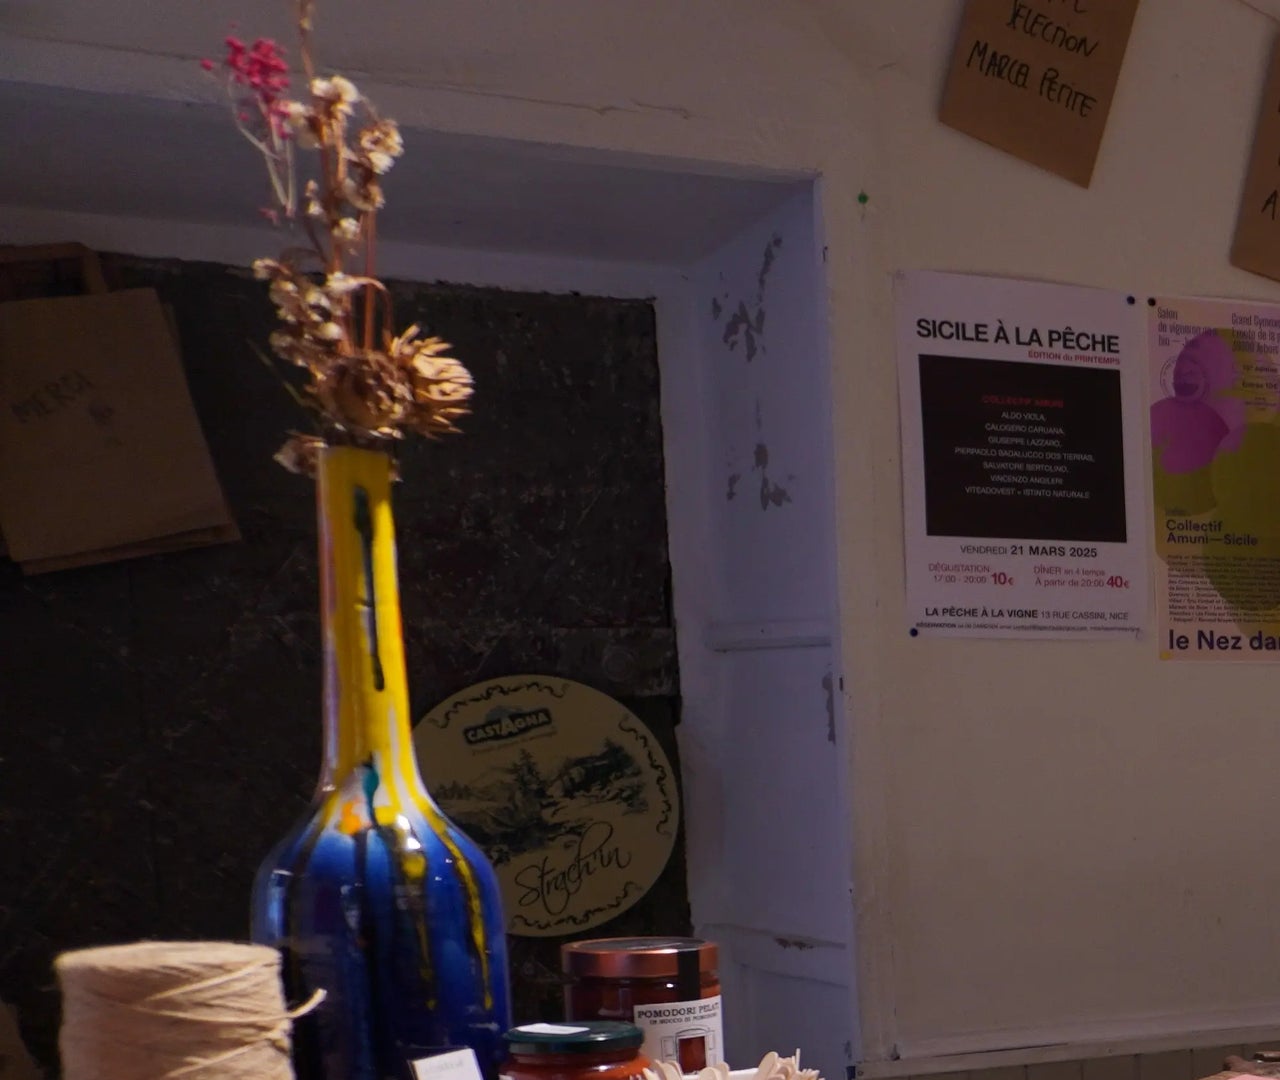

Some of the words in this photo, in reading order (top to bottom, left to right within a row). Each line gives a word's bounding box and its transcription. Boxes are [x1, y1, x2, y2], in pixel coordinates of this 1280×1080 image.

[916, 318, 989, 343] SICILE
[994, 319, 1009, 344] À
[1015, 327, 1043, 347] LA
[1048, 326, 1120, 353] PÊCHE
[1075, 355, 1120, 365] PRINTEMPS
[1166, 519, 1223, 532] Collectif
[960, 545, 1008, 555] VENDREDI
[1010, 545, 1024, 556] 21
[1029, 545, 1065, 557] MARS
[1069, 546, 1097, 558] 2025
[1044, 578, 1066, 589] partir
[1068, 578, 1079, 587] de
[925, 607, 940, 617] LA
[942, 606, 979, 618] PÊCHE
[980, 606, 990, 618] À
[991, 608, 1006, 618] LA
[1007, 609, 1039, 619] VIGNE
[1052, 610, 1069, 620] RUE
[1109, 612, 1129, 621] NICE
[1169, 629, 1189, 650] le
[1197, 630, 1242, 650] Nez
[638, 1006, 696, 1019] POMODORI
